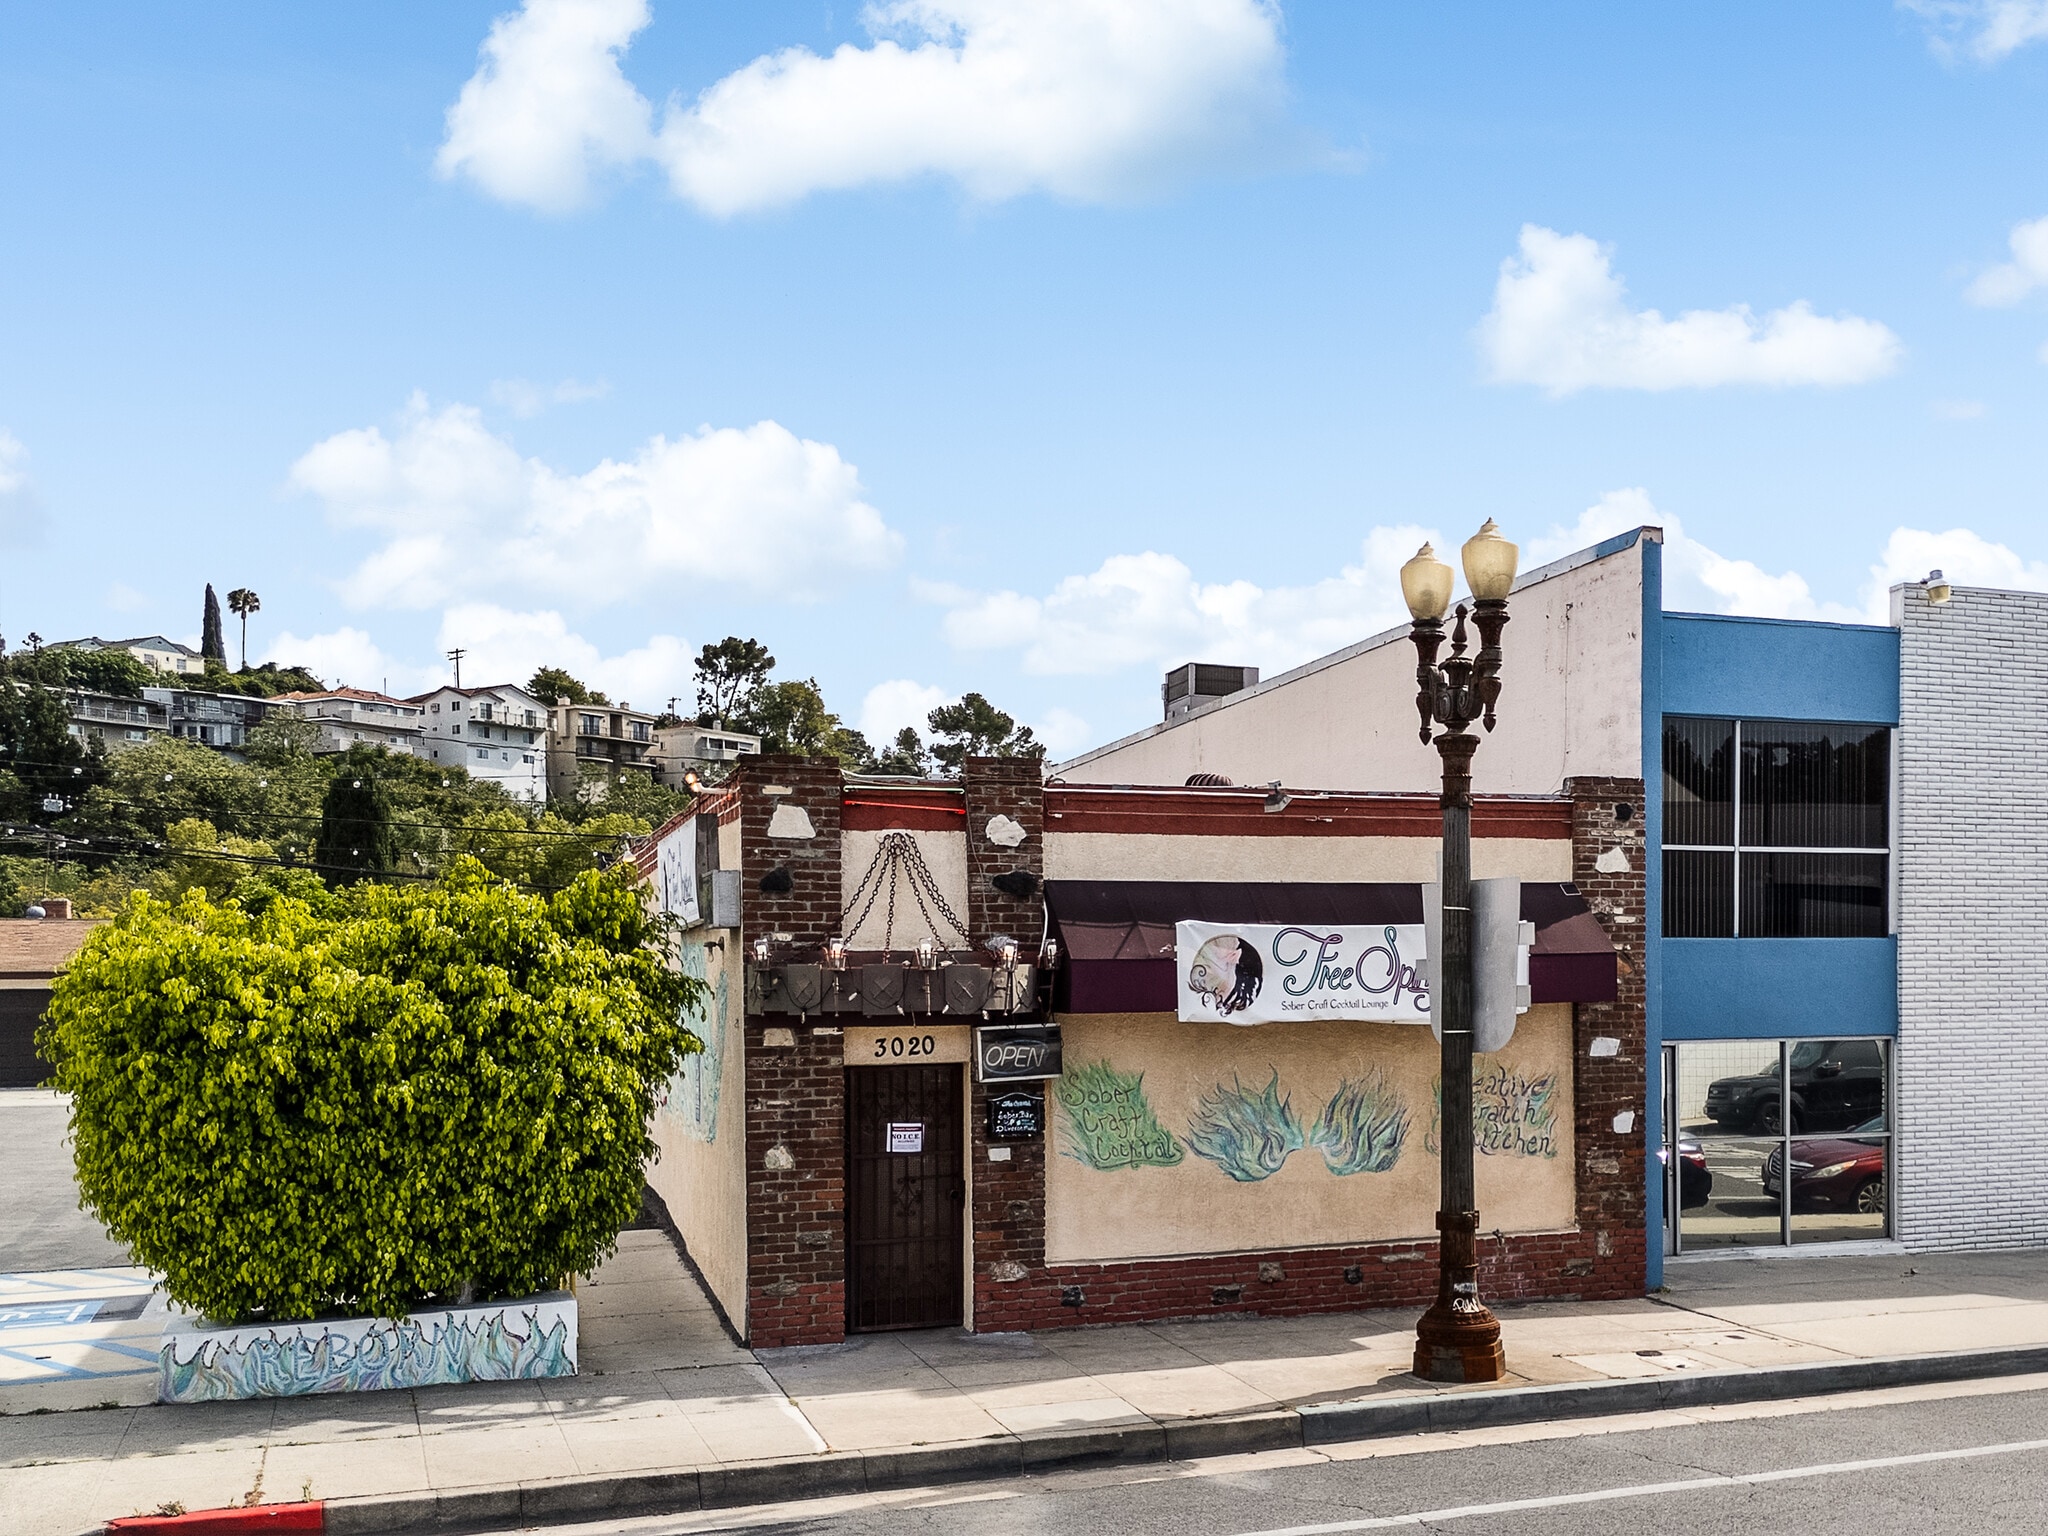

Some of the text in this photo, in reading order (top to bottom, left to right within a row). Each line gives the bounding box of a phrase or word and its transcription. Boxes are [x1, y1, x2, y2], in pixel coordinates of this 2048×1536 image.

[1272, 927, 1353, 997] Free
[1281, 998, 1389, 1011] Sober Craft Cocktail Lounge
[874, 1035, 935, 1058] 3020
[985, 1046, 1045, 1068] OPEN
[1064, 1073, 1136, 1107] Sober
[1473, 1070, 1549, 1098] eative
[1082, 1106, 1145, 1138] Craft
[1096, 1136, 1184, 1166] Cocktails
[251, 1322, 468, 1384] REBORN
